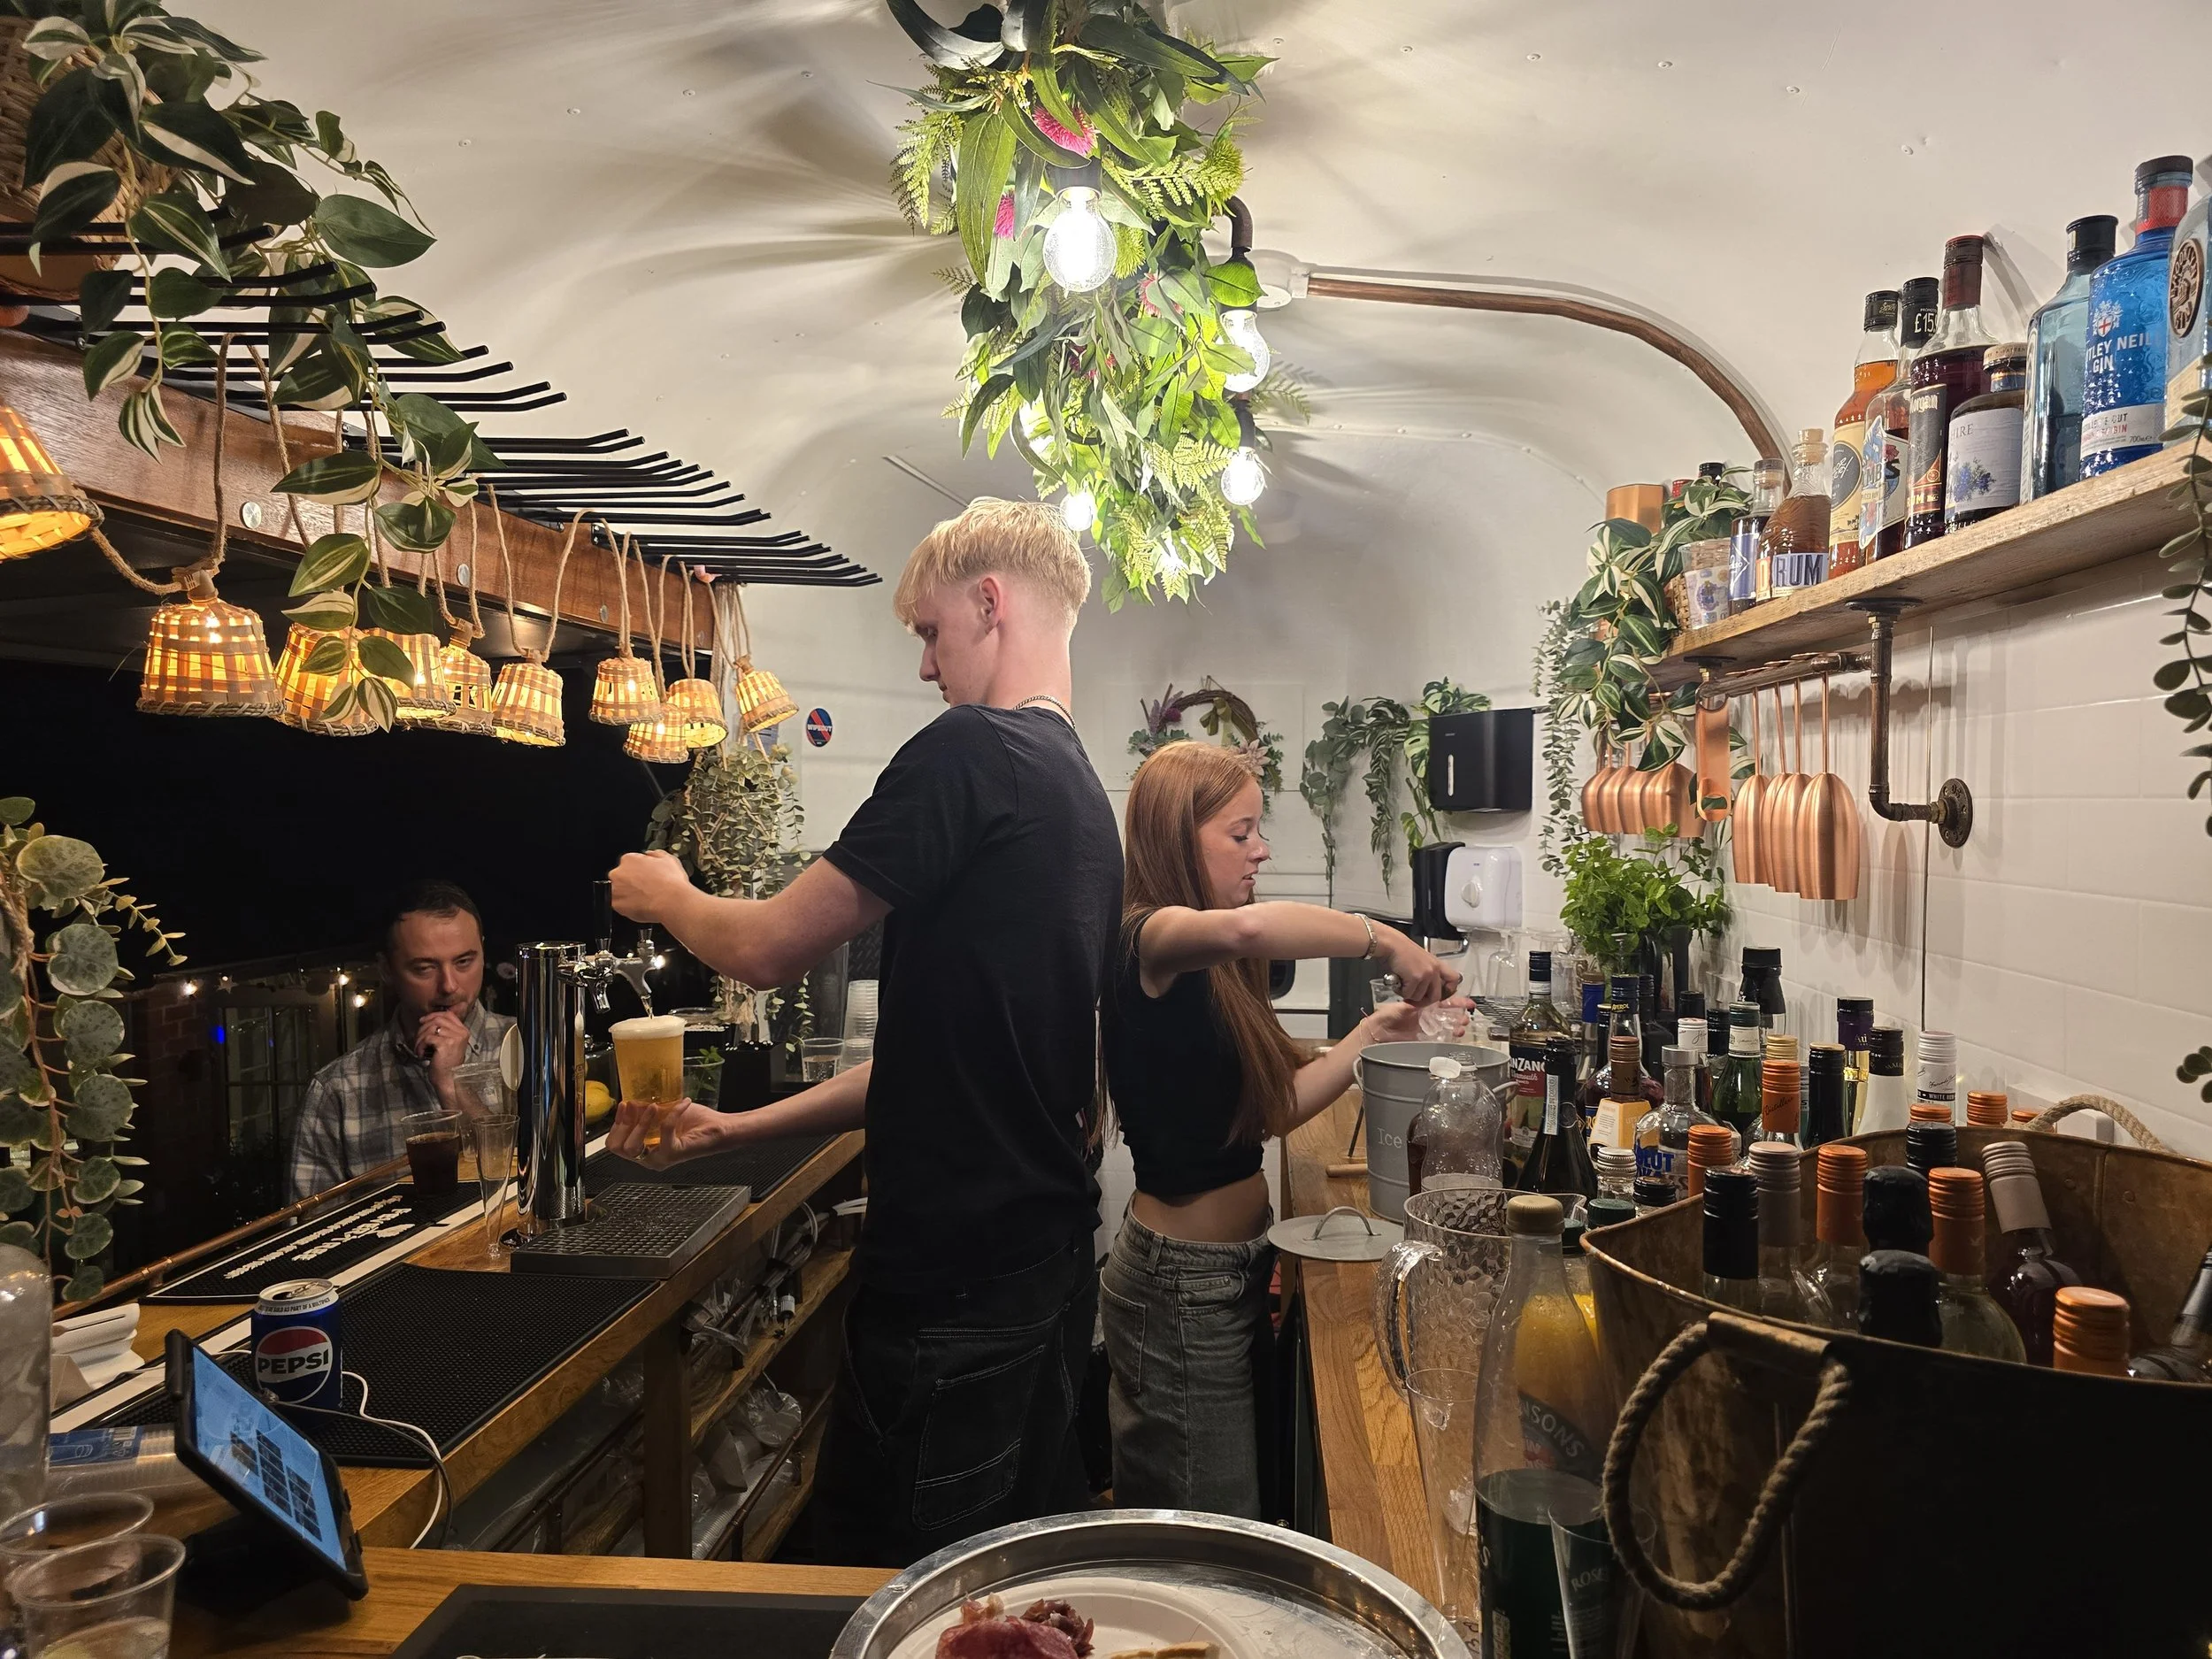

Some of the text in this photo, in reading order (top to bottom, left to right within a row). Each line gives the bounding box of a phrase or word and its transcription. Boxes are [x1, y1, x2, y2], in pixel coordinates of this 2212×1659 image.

[2093, 355, 2115, 373] GIN
[1775, 554, 1824, 588] RUM
[1377, 1127, 1402, 1148] Ice
[257, 1349, 329, 1374] PEPSI
